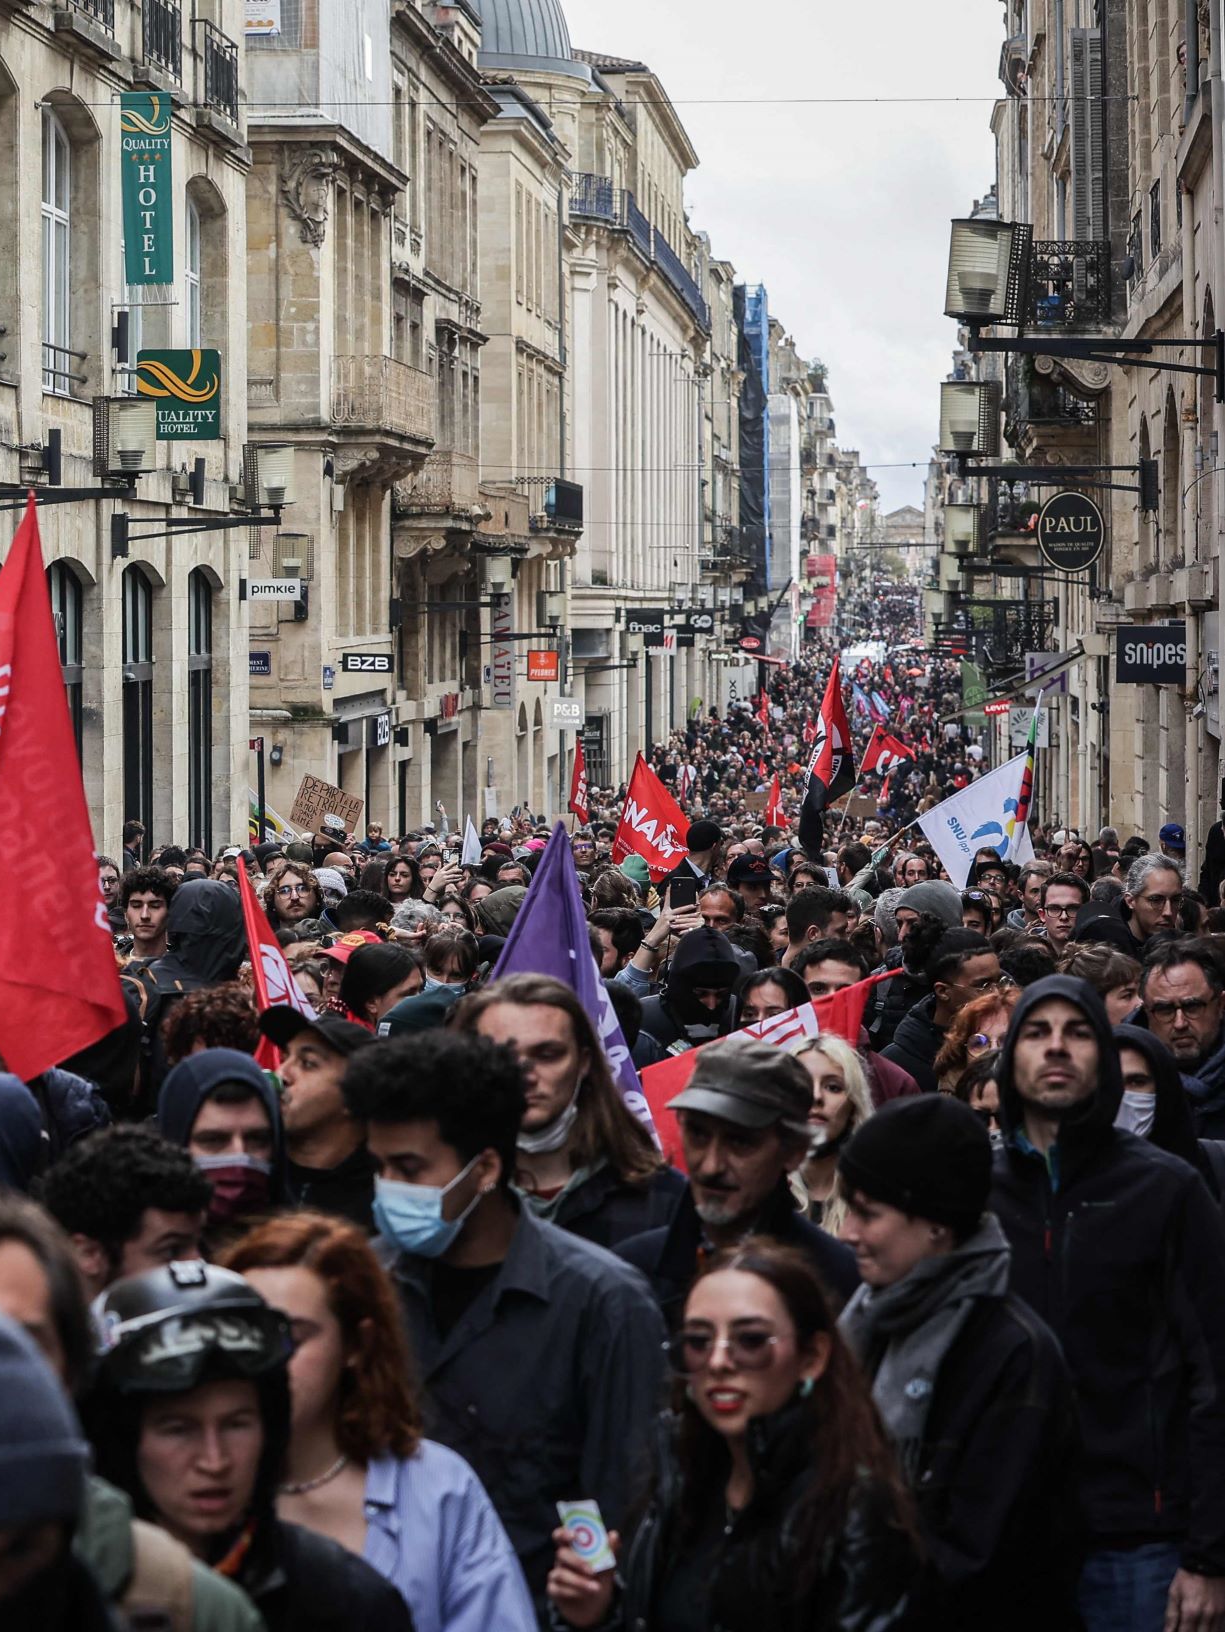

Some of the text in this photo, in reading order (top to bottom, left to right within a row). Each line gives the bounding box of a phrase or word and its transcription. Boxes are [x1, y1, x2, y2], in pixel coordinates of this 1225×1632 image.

[122, 137, 170, 151] QUALITY
[137, 165, 156, 276] HOTEL
[156, 410, 216, 424] UALITY
[160, 423, 198, 434] HOTEL
[1044, 516, 1098, 533] PAUL
[251, 585, 296, 596] pimkie
[629, 622, 662, 632] fnac
[1124, 642, 1186, 669] snipes
[348, 656, 389, 670] BZB
[554, 704, 580, 716] P&B
[378, 714, 390, 746] BZB
[300, 788, 357, 824] RETRAITE
